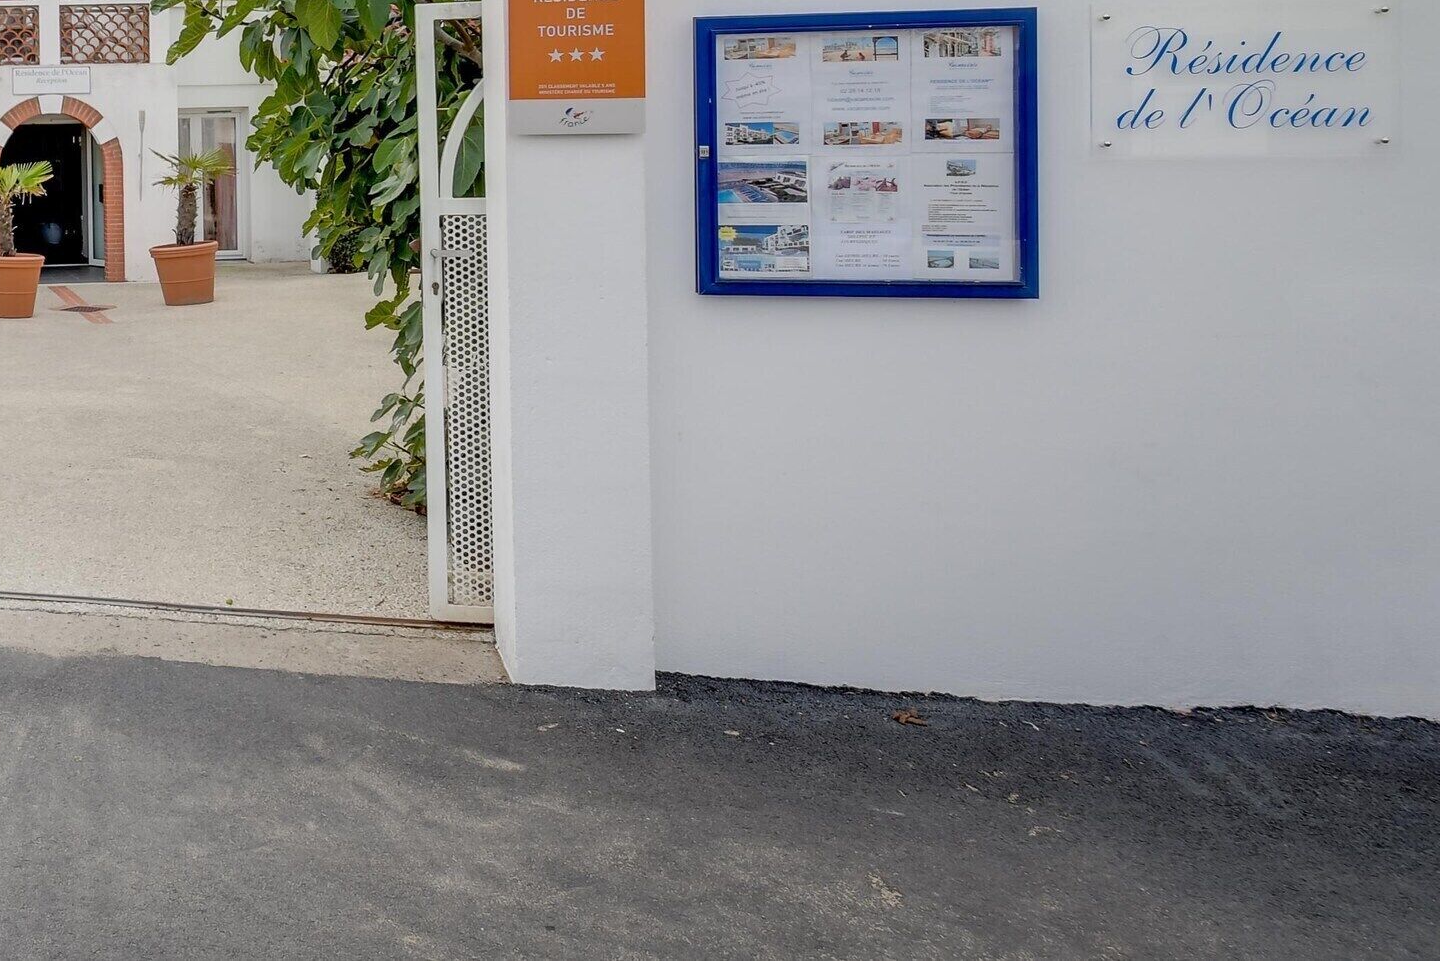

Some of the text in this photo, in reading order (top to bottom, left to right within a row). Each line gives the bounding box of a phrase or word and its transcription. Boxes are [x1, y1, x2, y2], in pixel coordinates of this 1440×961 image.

[566, 7, 586, 20] DE
[537, 24, 615, 38] TOURISME
[1125, 25, 1367, 76] Résidence
[1116, 88, 1165, 130] de
